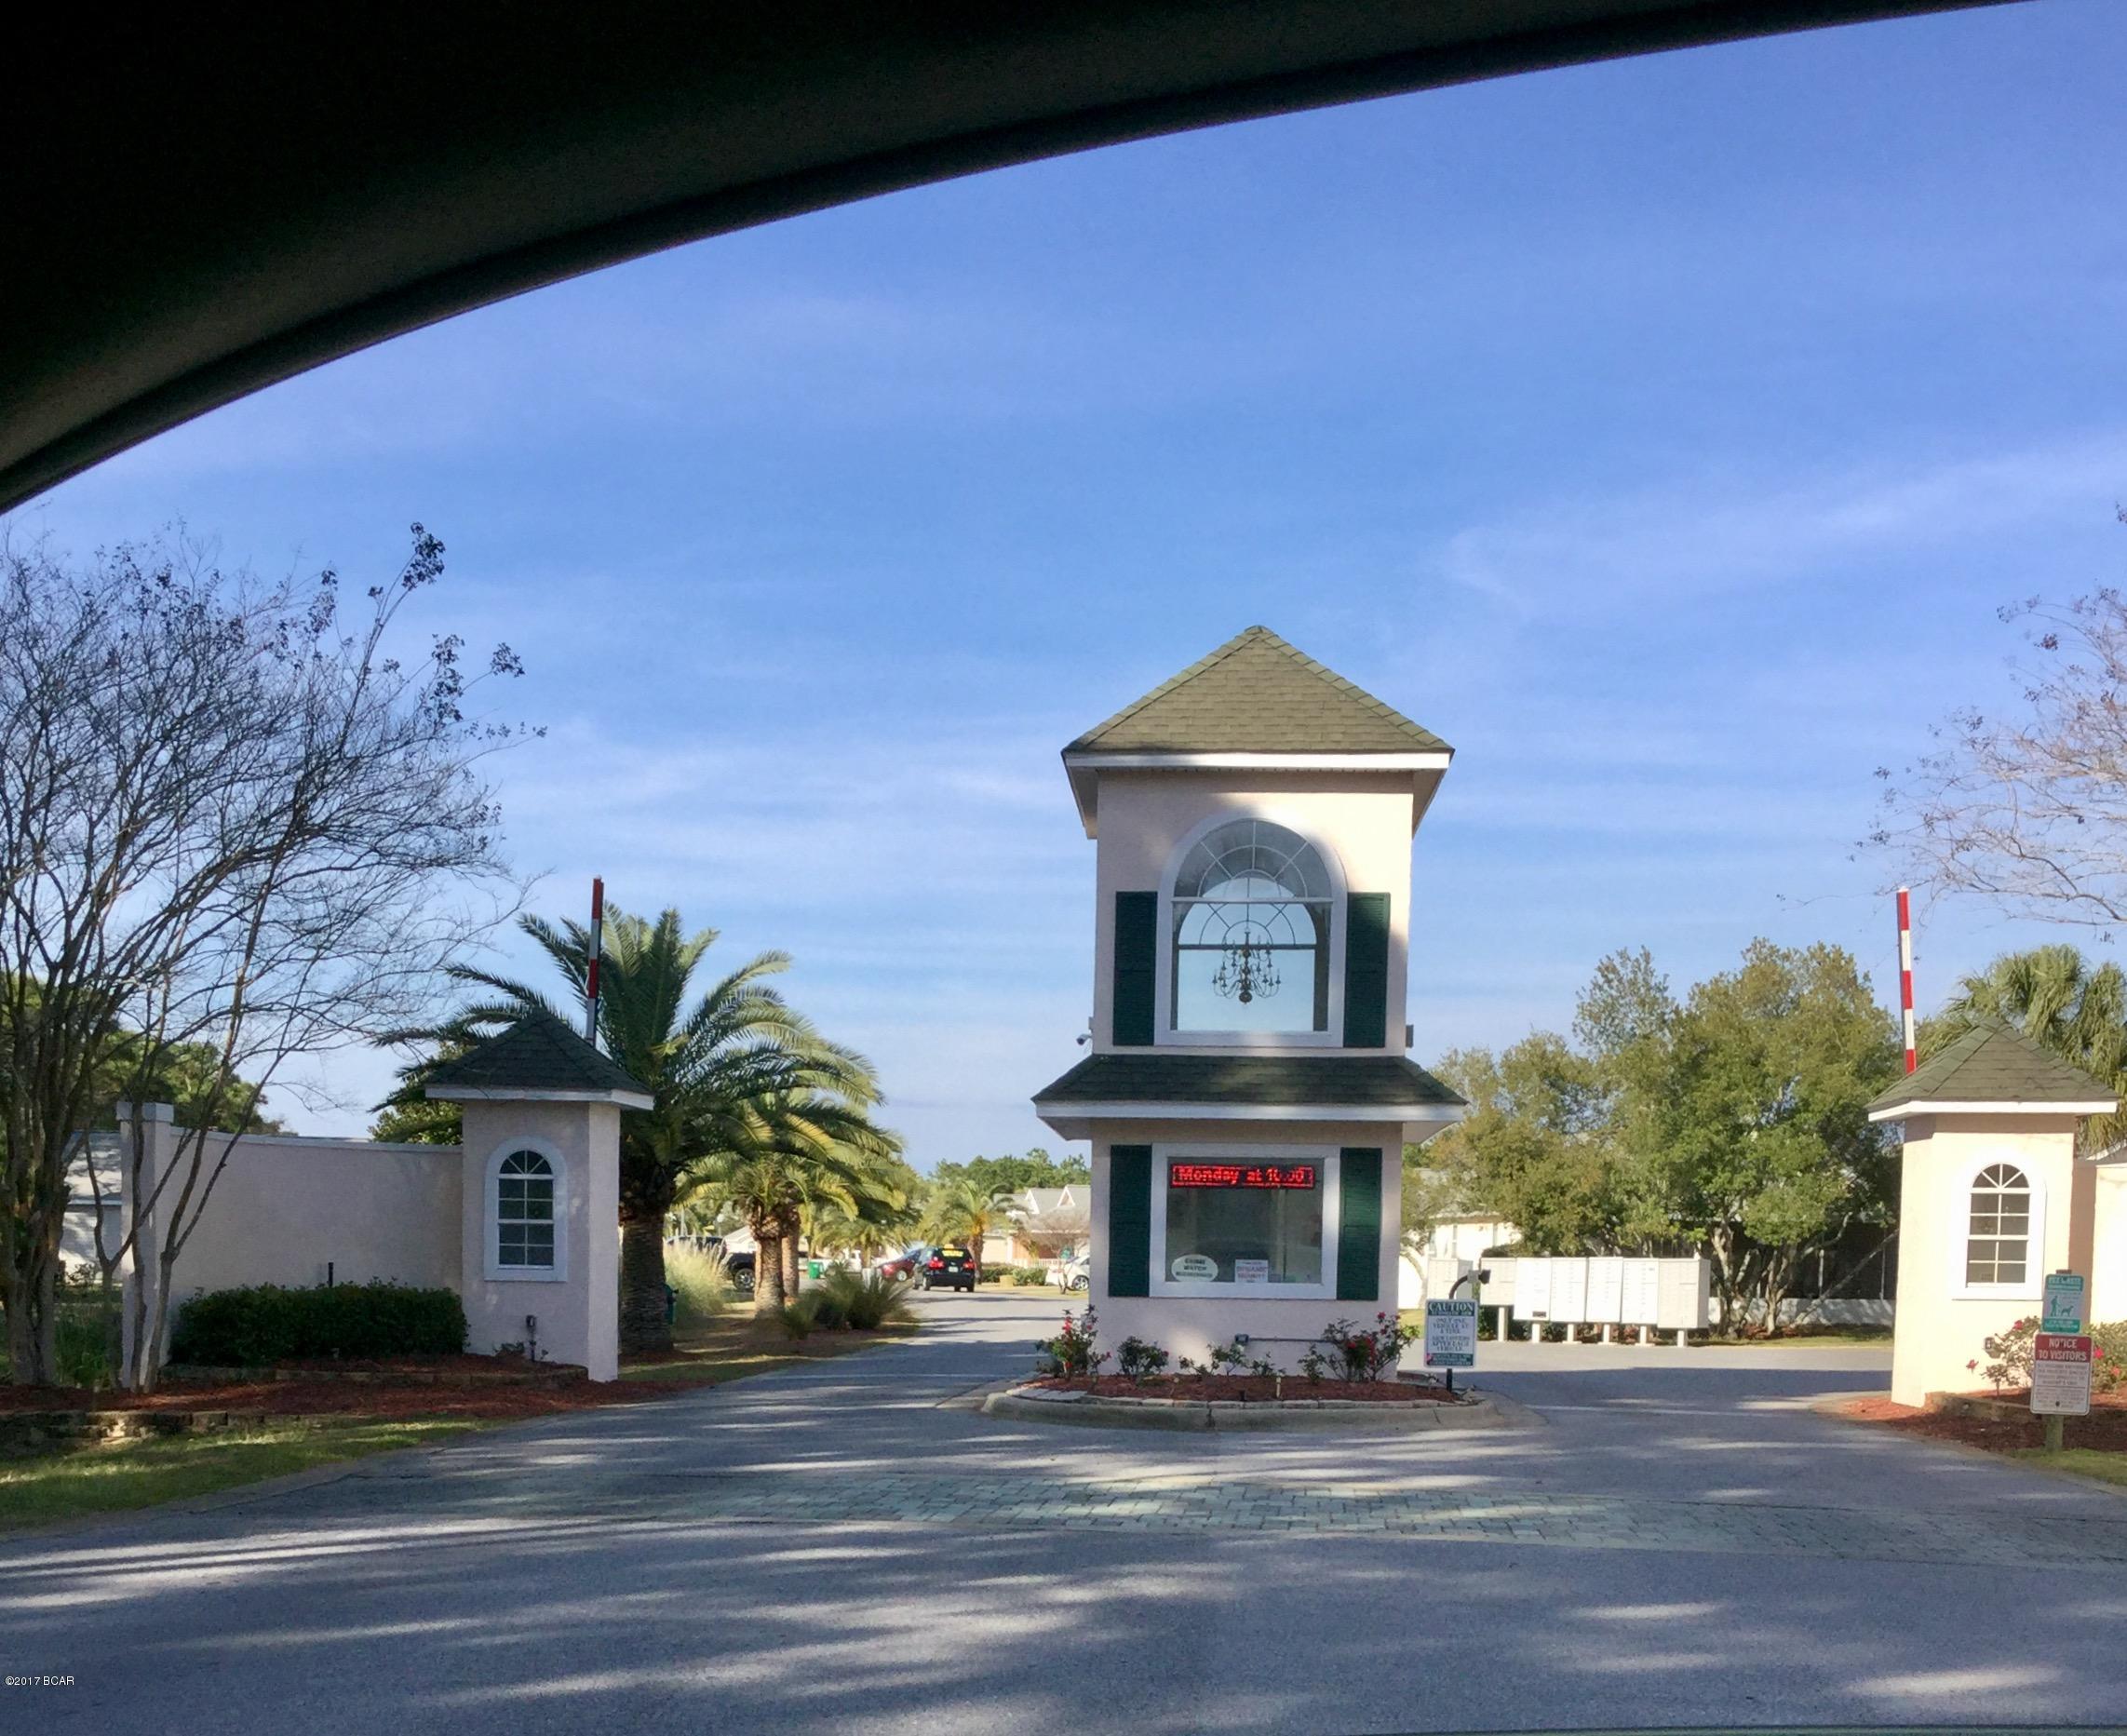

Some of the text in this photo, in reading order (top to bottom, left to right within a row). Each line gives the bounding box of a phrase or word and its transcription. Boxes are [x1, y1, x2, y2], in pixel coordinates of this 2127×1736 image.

[1178, 1166, 1239, 1185] Monday
[1246, 1168, 1262, 1181] at
[1429, 1302, 1474, 1312] CAUTION
[2049, 1338, 2078, 1349] NOTICE
[2039, 1350, 2087, 1361] TO VISITORS
